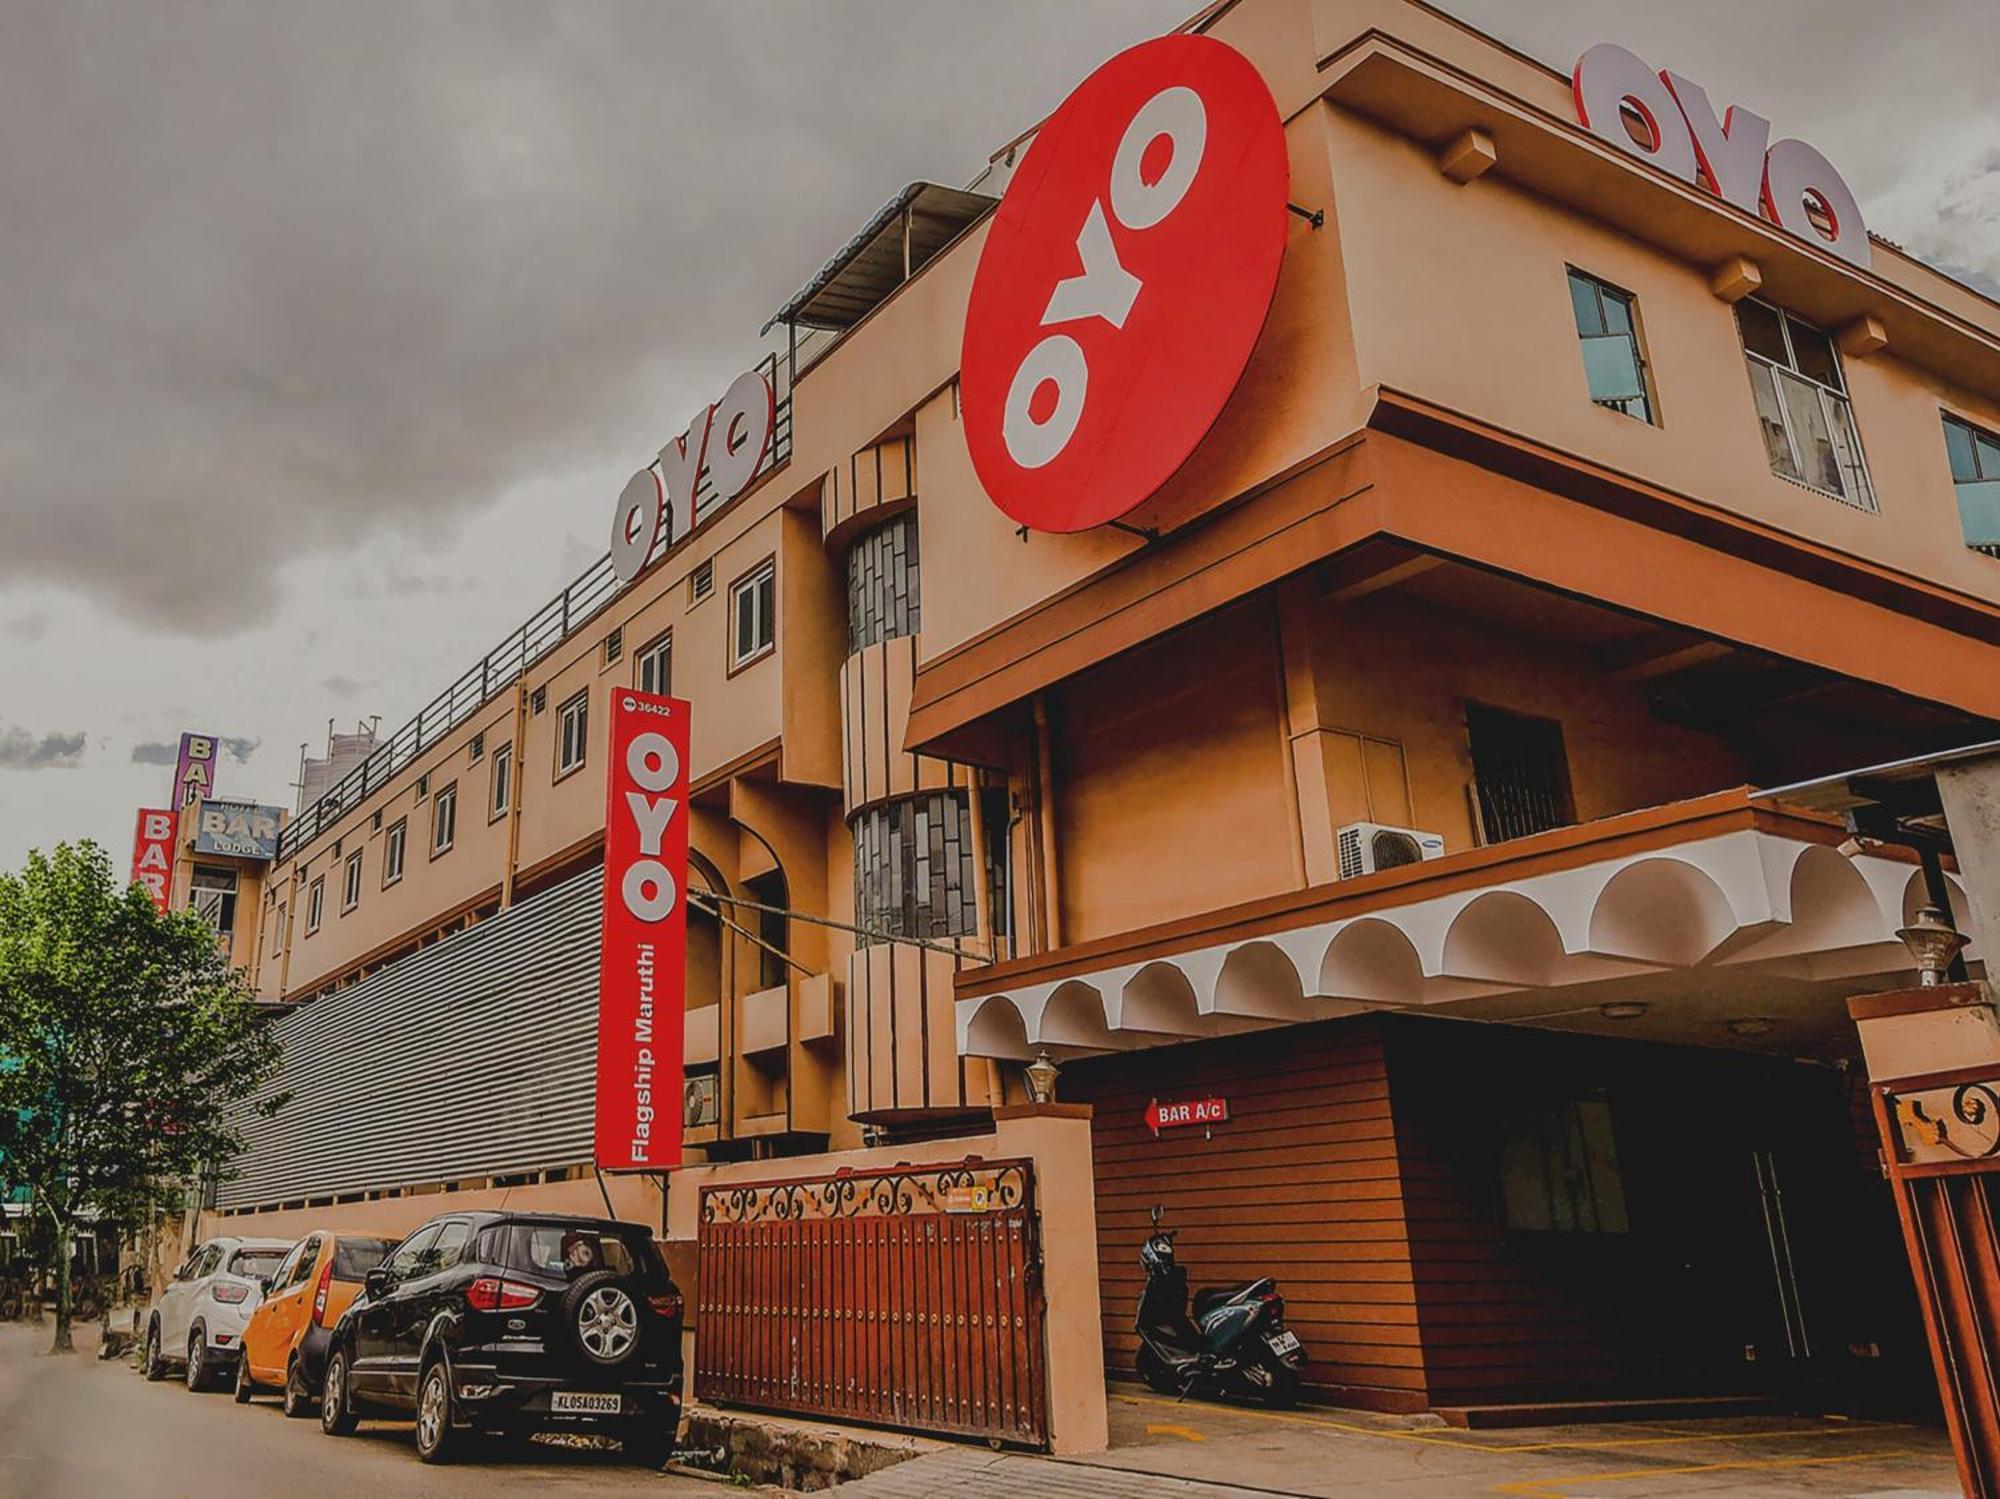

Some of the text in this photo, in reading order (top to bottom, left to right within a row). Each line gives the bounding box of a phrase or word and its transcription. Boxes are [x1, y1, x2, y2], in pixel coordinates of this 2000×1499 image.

[1572, 43, 1871, 270] OYO
[1002, 86, 1208, 469] OYO
[611, 371, 775, 582] OYO
[637, 702, 671, 717] 36422
[139, 814, 171, 899] BAR
[202, 811, 277, 840] BAR
[214, 840, 260, 855] LODGE
[622, 732, 679, 922] OYO
[631, 943, 655, 1162] Flagship Maruthi
[1159, 1105, 1190, 1122] BAR
